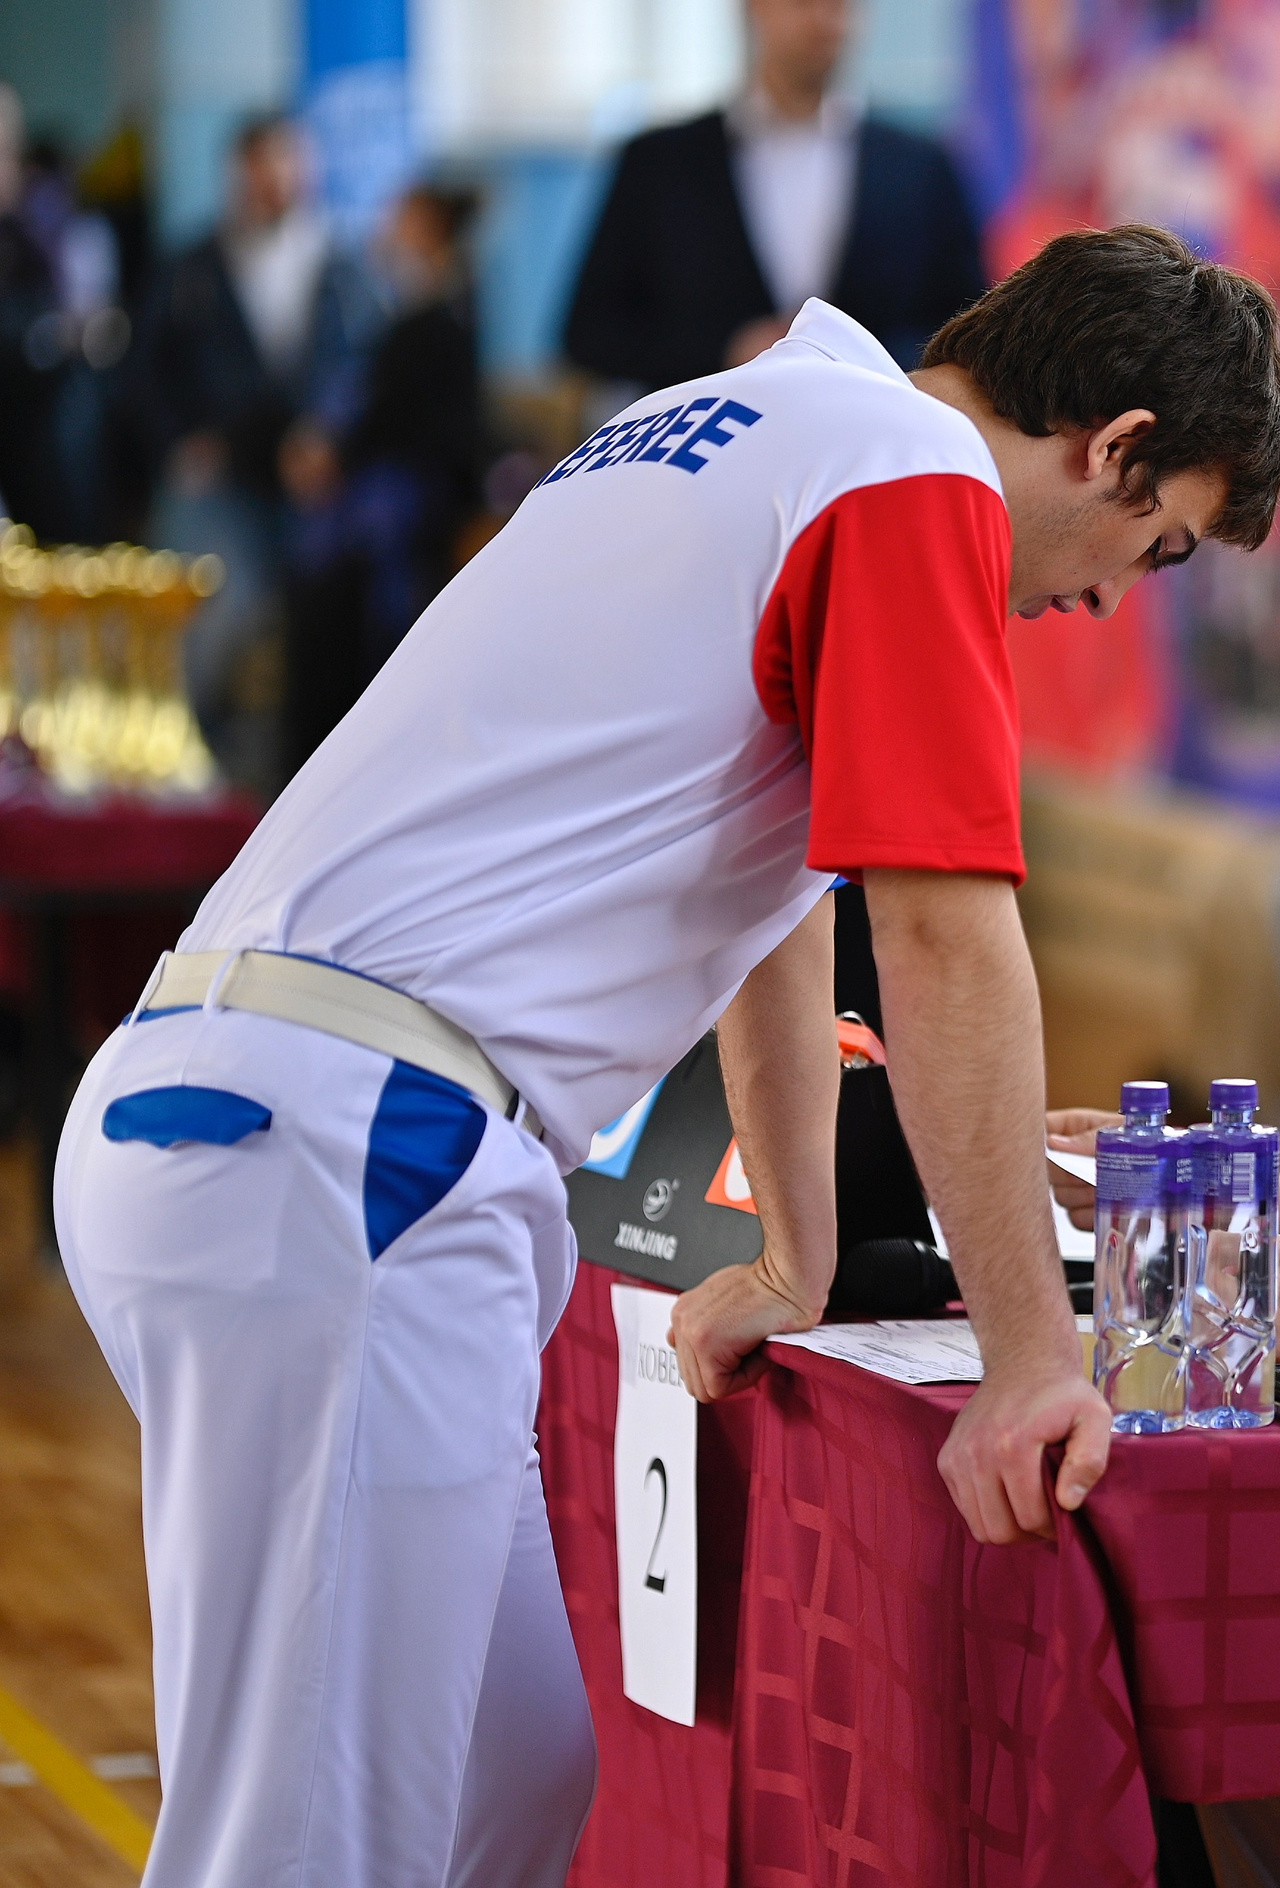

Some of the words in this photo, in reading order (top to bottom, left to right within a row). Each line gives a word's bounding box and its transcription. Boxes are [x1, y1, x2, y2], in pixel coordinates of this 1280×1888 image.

[532, 397, 764, 491] EFEREE
[613, 1221, 679, 1262] XINJING
[638, 1342, 681, 1388] КОВЕ
[642, 1456, 668, 1594] 2
